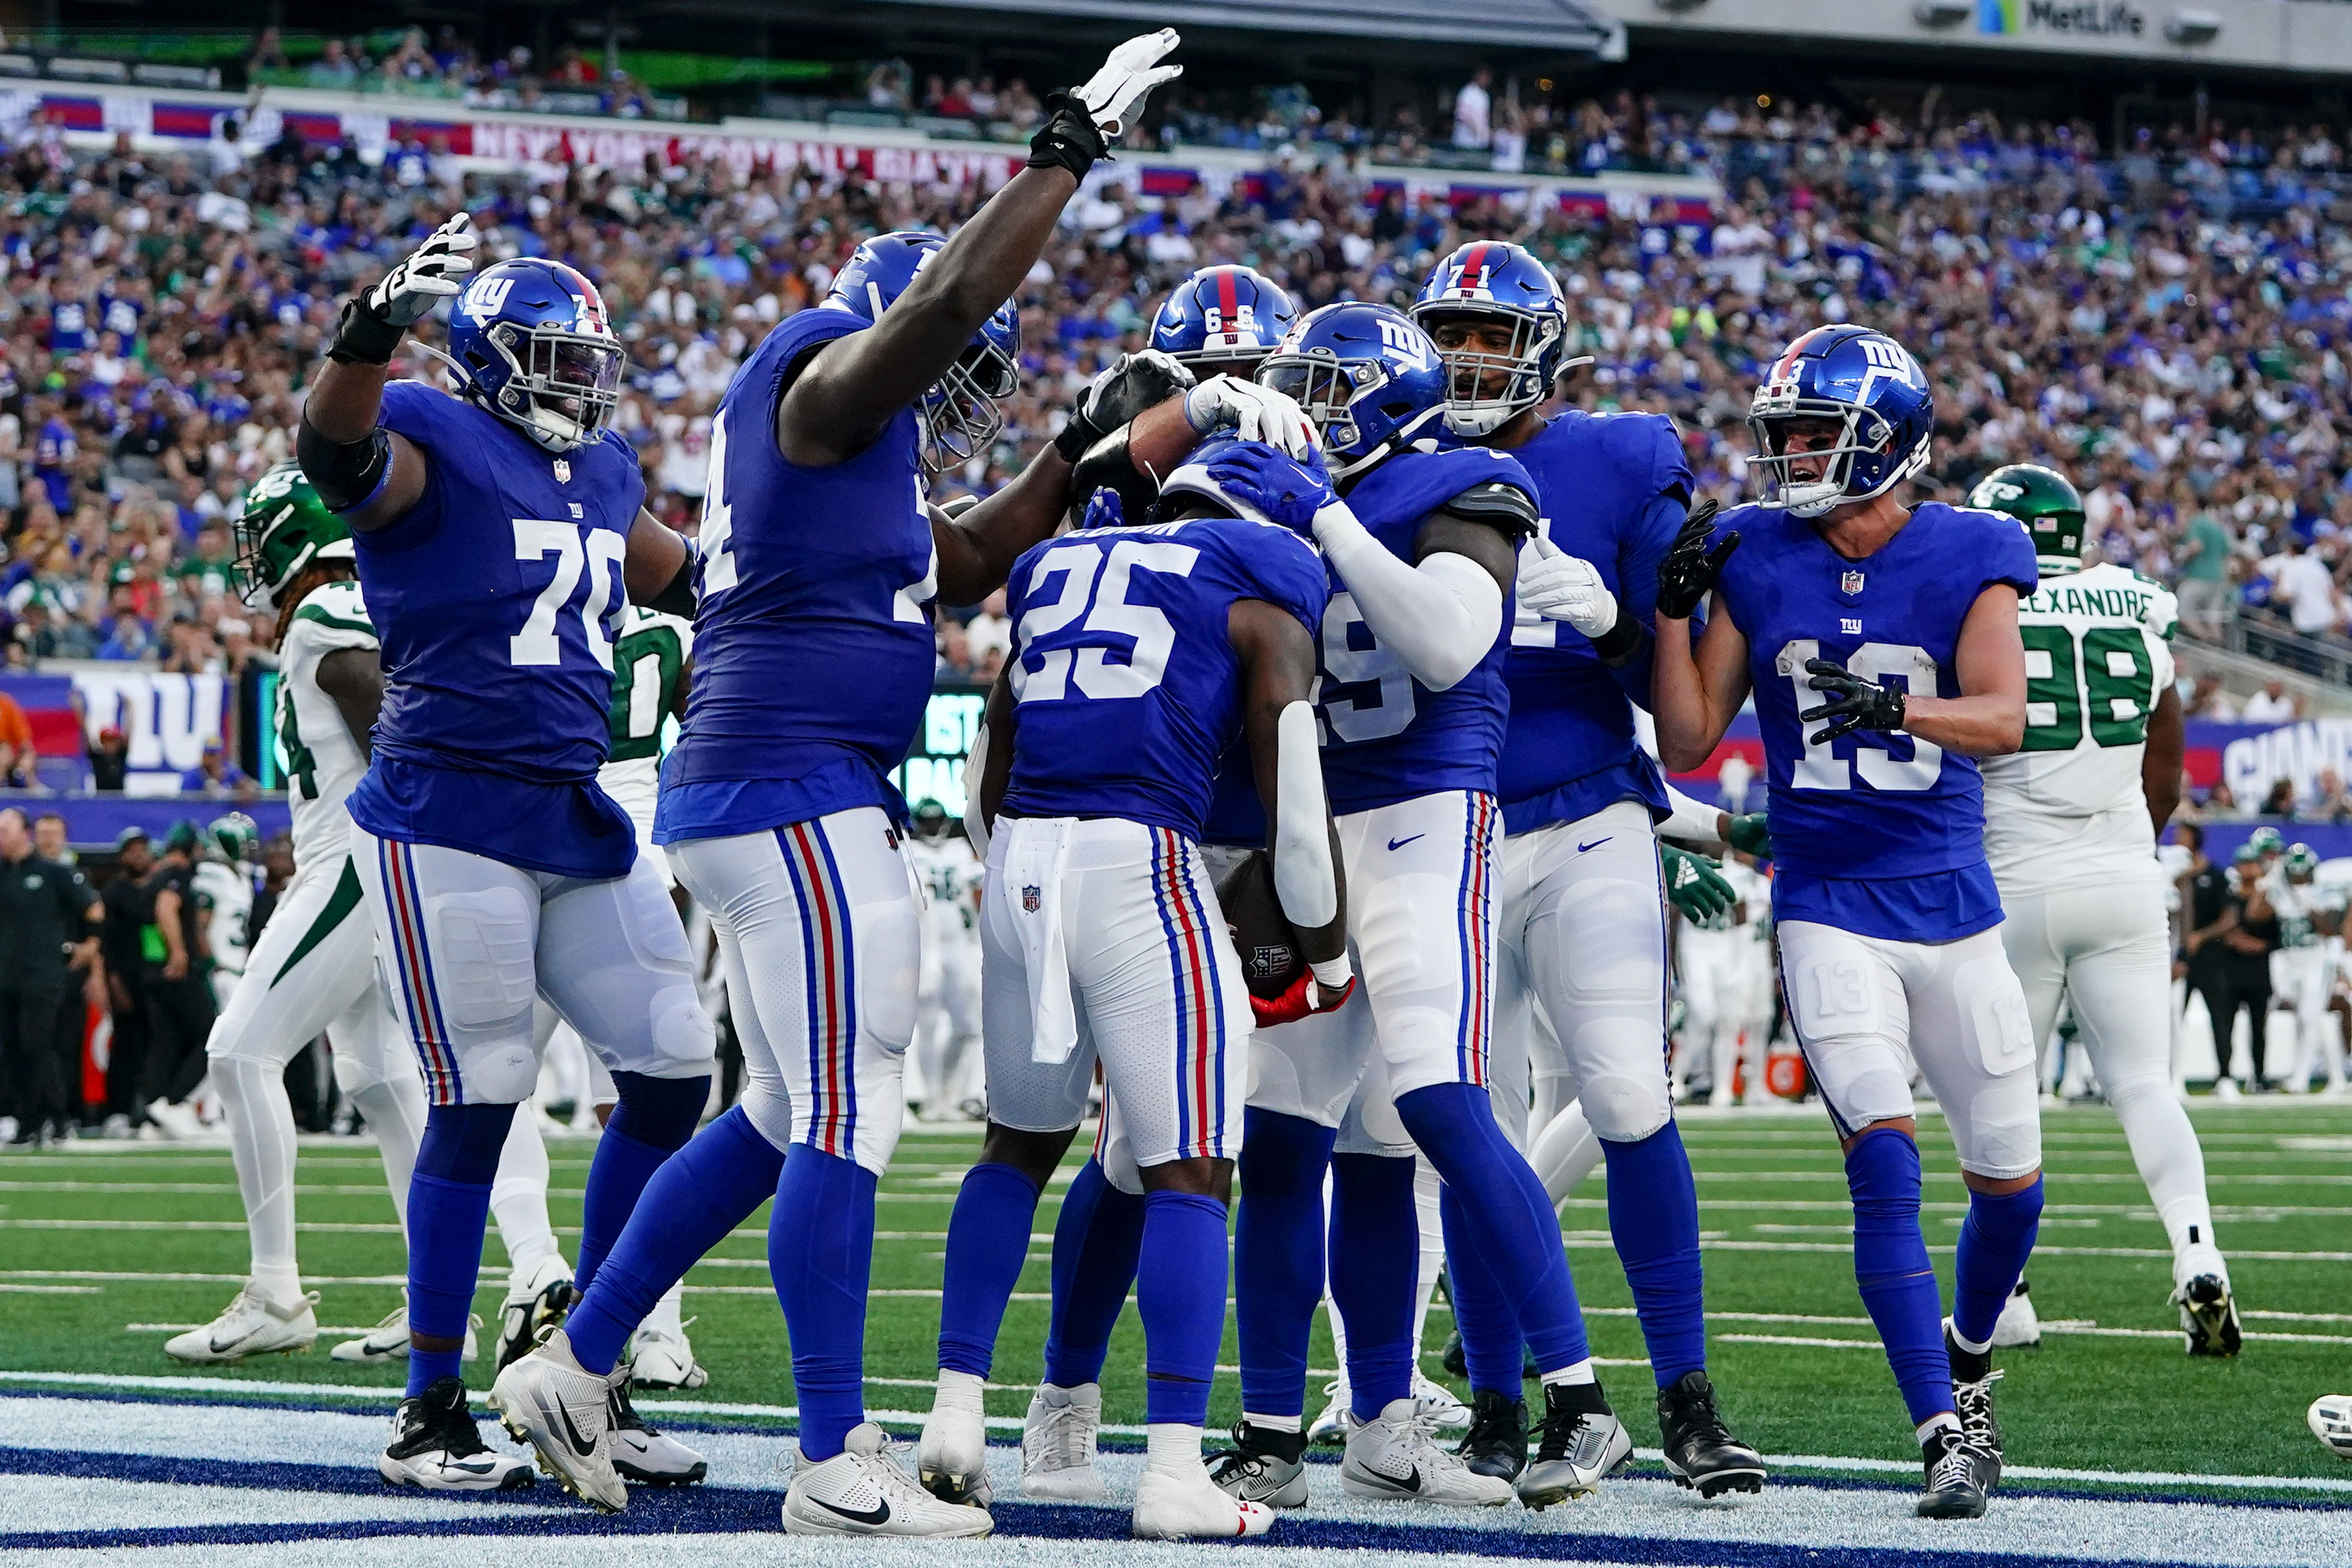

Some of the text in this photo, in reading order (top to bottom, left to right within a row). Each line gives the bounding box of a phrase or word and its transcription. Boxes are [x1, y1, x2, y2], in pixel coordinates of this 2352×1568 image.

[2028, 1, 2145, 36] MetLife
[1446, 265, 1490, 288] 71
[510, 519, 630, 673] 70
[1846, 582, 1859, 591] NFL
[1008, 540, 1201, 705] 25
[1839, 618, 1862, 635] ny
[1775, 640, 1942, 790] 13
[1024, 896, 1039, 910] NFL
[1814, 960, 1869, 1016] 13
[801, 1510, 846, 1529] FORCE
